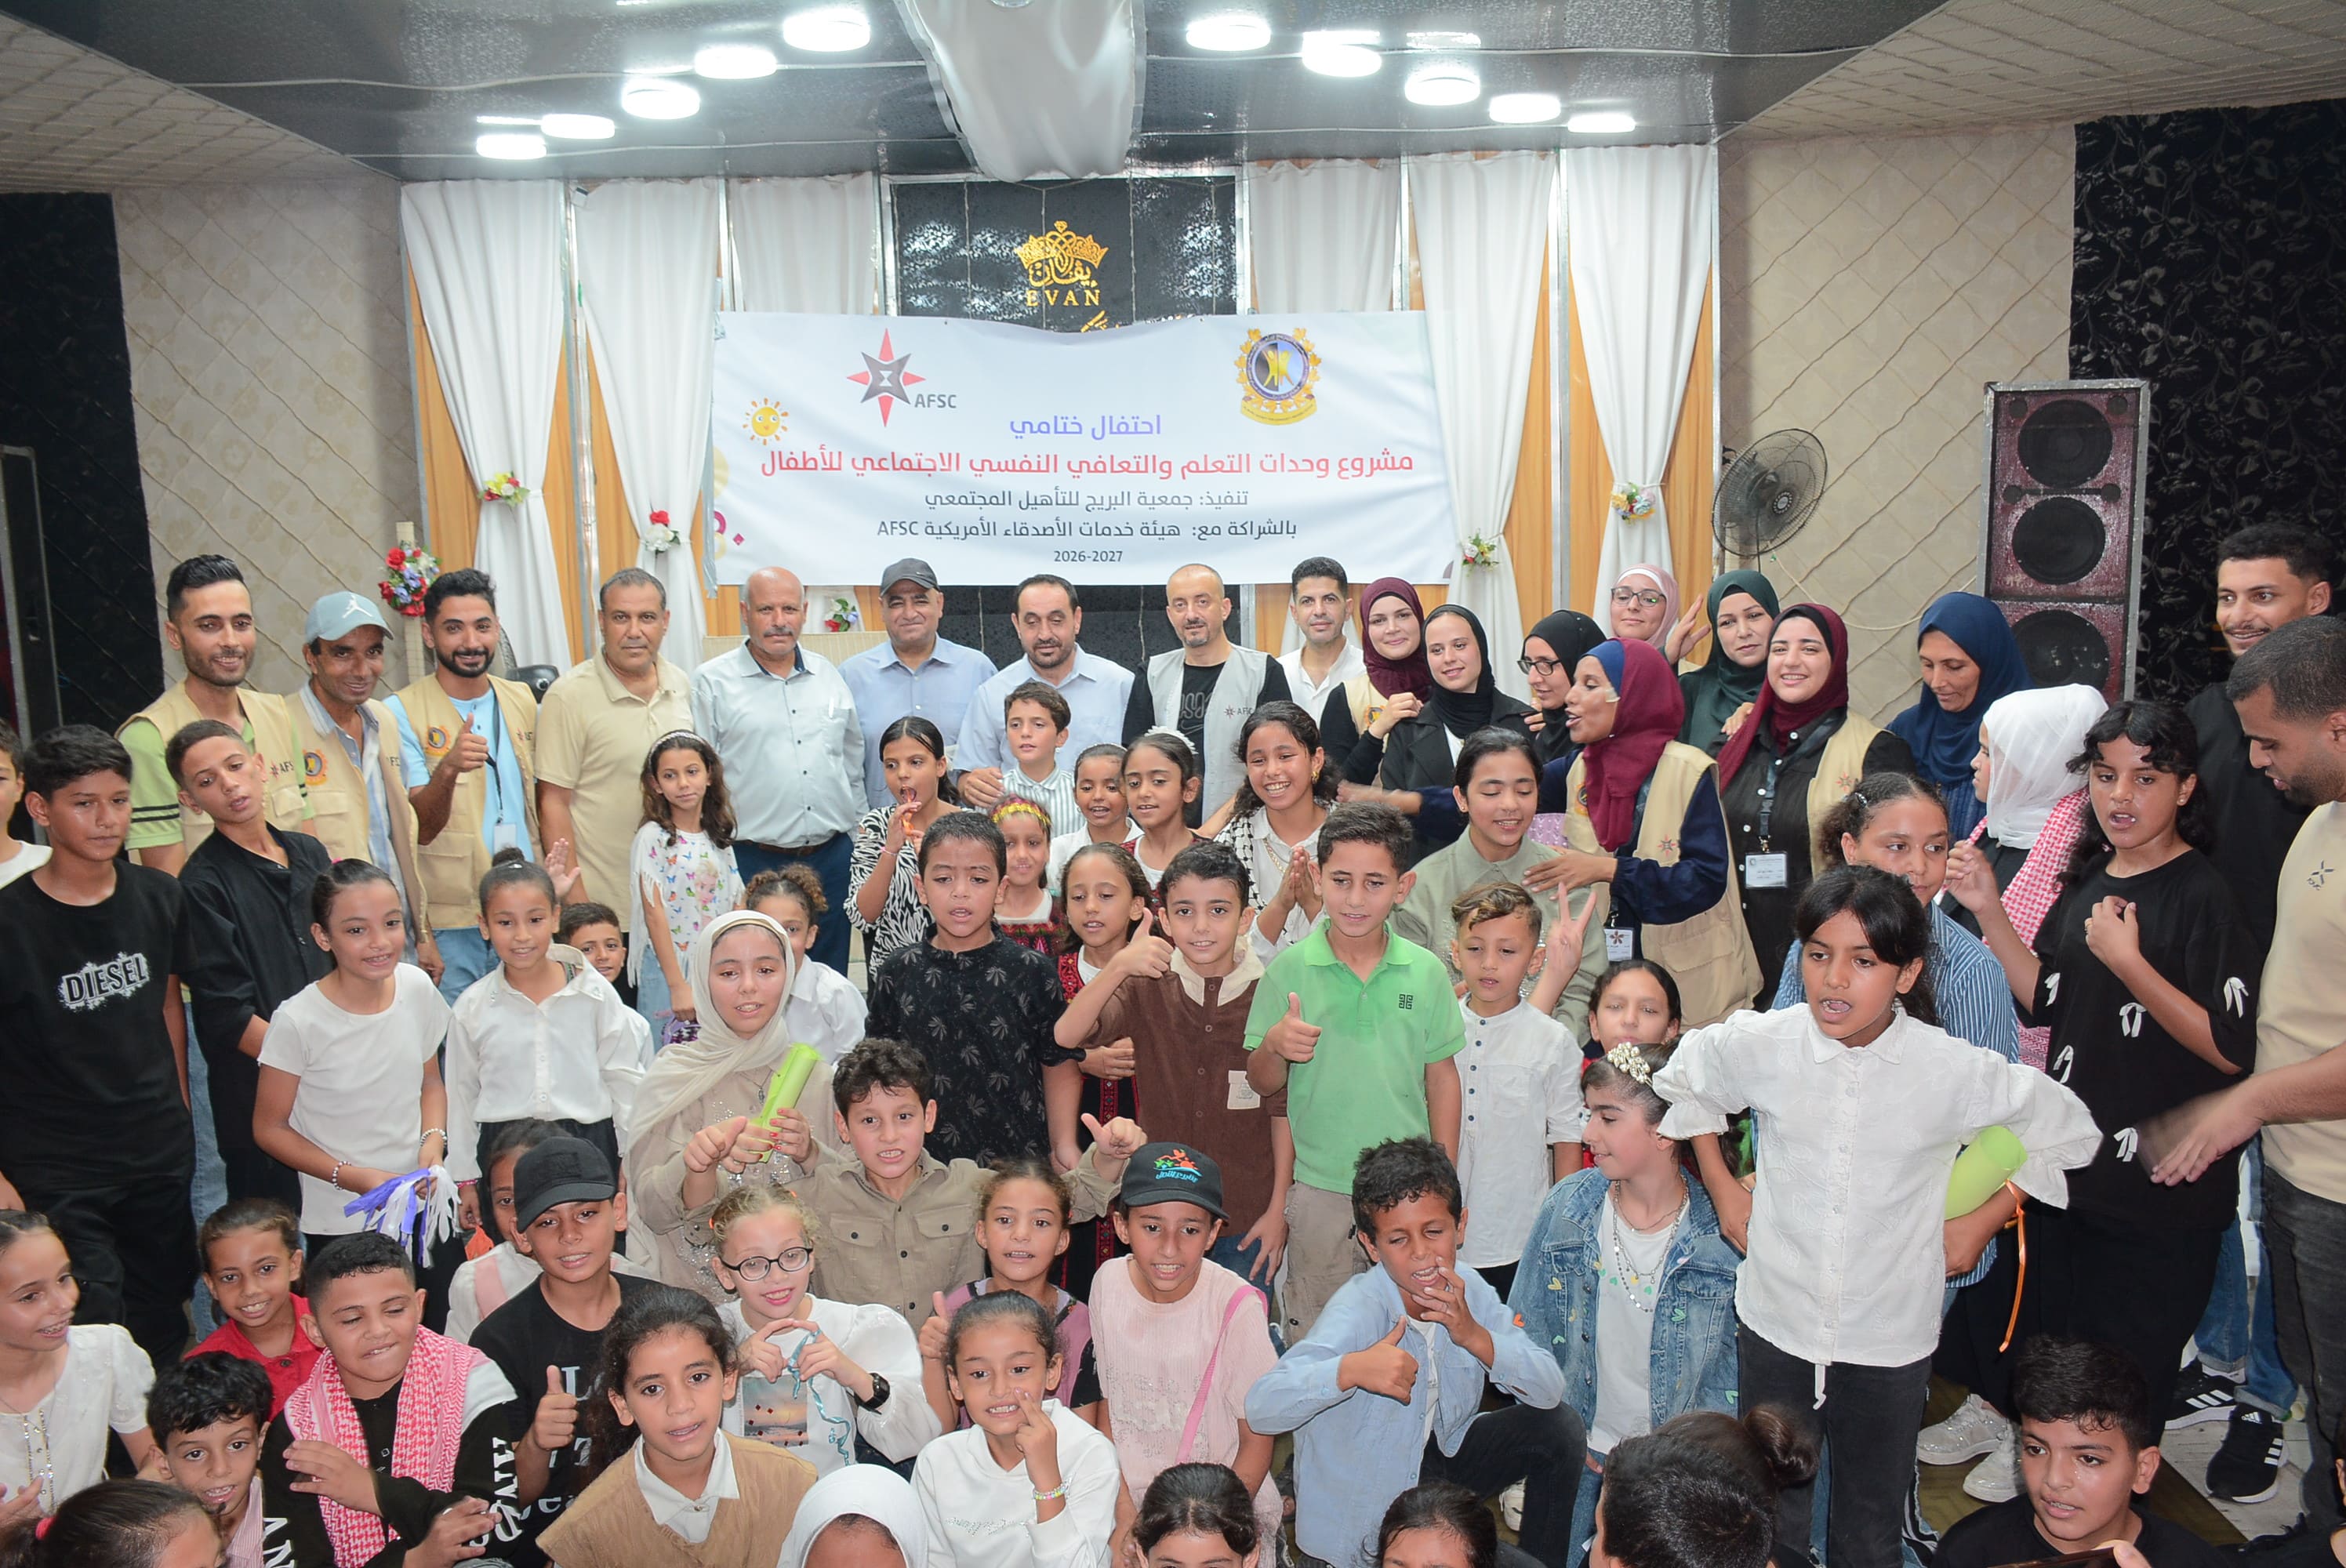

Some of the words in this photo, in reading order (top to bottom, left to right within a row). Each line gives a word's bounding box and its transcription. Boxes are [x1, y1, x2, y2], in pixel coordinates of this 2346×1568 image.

[1026, 289, 1101, 307] EVAN
[914, 394, 957, 409] AFSC
[1010, 415, 1083, 440] ختامي
[1091, 414, 1160, 441] احتفال
[761, 444, 842, 477] للأطفال
[851, 451, 961, 477] الاجتماعي
[969, 454, 1058, 477] النفسي
[1066, 454, 1172, 481] والتعافي
[1180, 453, 1251, 481] التعلم
[1259, 452, 1330, 478] وحدات
[1337, 447, 1414, 480] مشروع
[924, 490, 1012, 510] المجتمعي
[1018, 485, 1080, 511] للتأهيل
[1085, 491, 1131, 513] البريج
[1137, 492, 1193, 510] جمعية
[1200, 491, 1249, 510] تنفيذ:
[877, 521, 919, 536] AFSC
[924, 516, 997, 541] الأمريكية
[1003, 516, 1073, 537] الأصدقاء
[1079, 521, 1134, 537] خدمات
[1139, 520, 1181, 541] هيئة
[1192, 525, 1222, 541] مع:
[1227, 517, 1297, 541] بالشراكة
[1053, 550, 1124, 563] 2026-2027
[64, 955, 147, 1004] DIESEL
